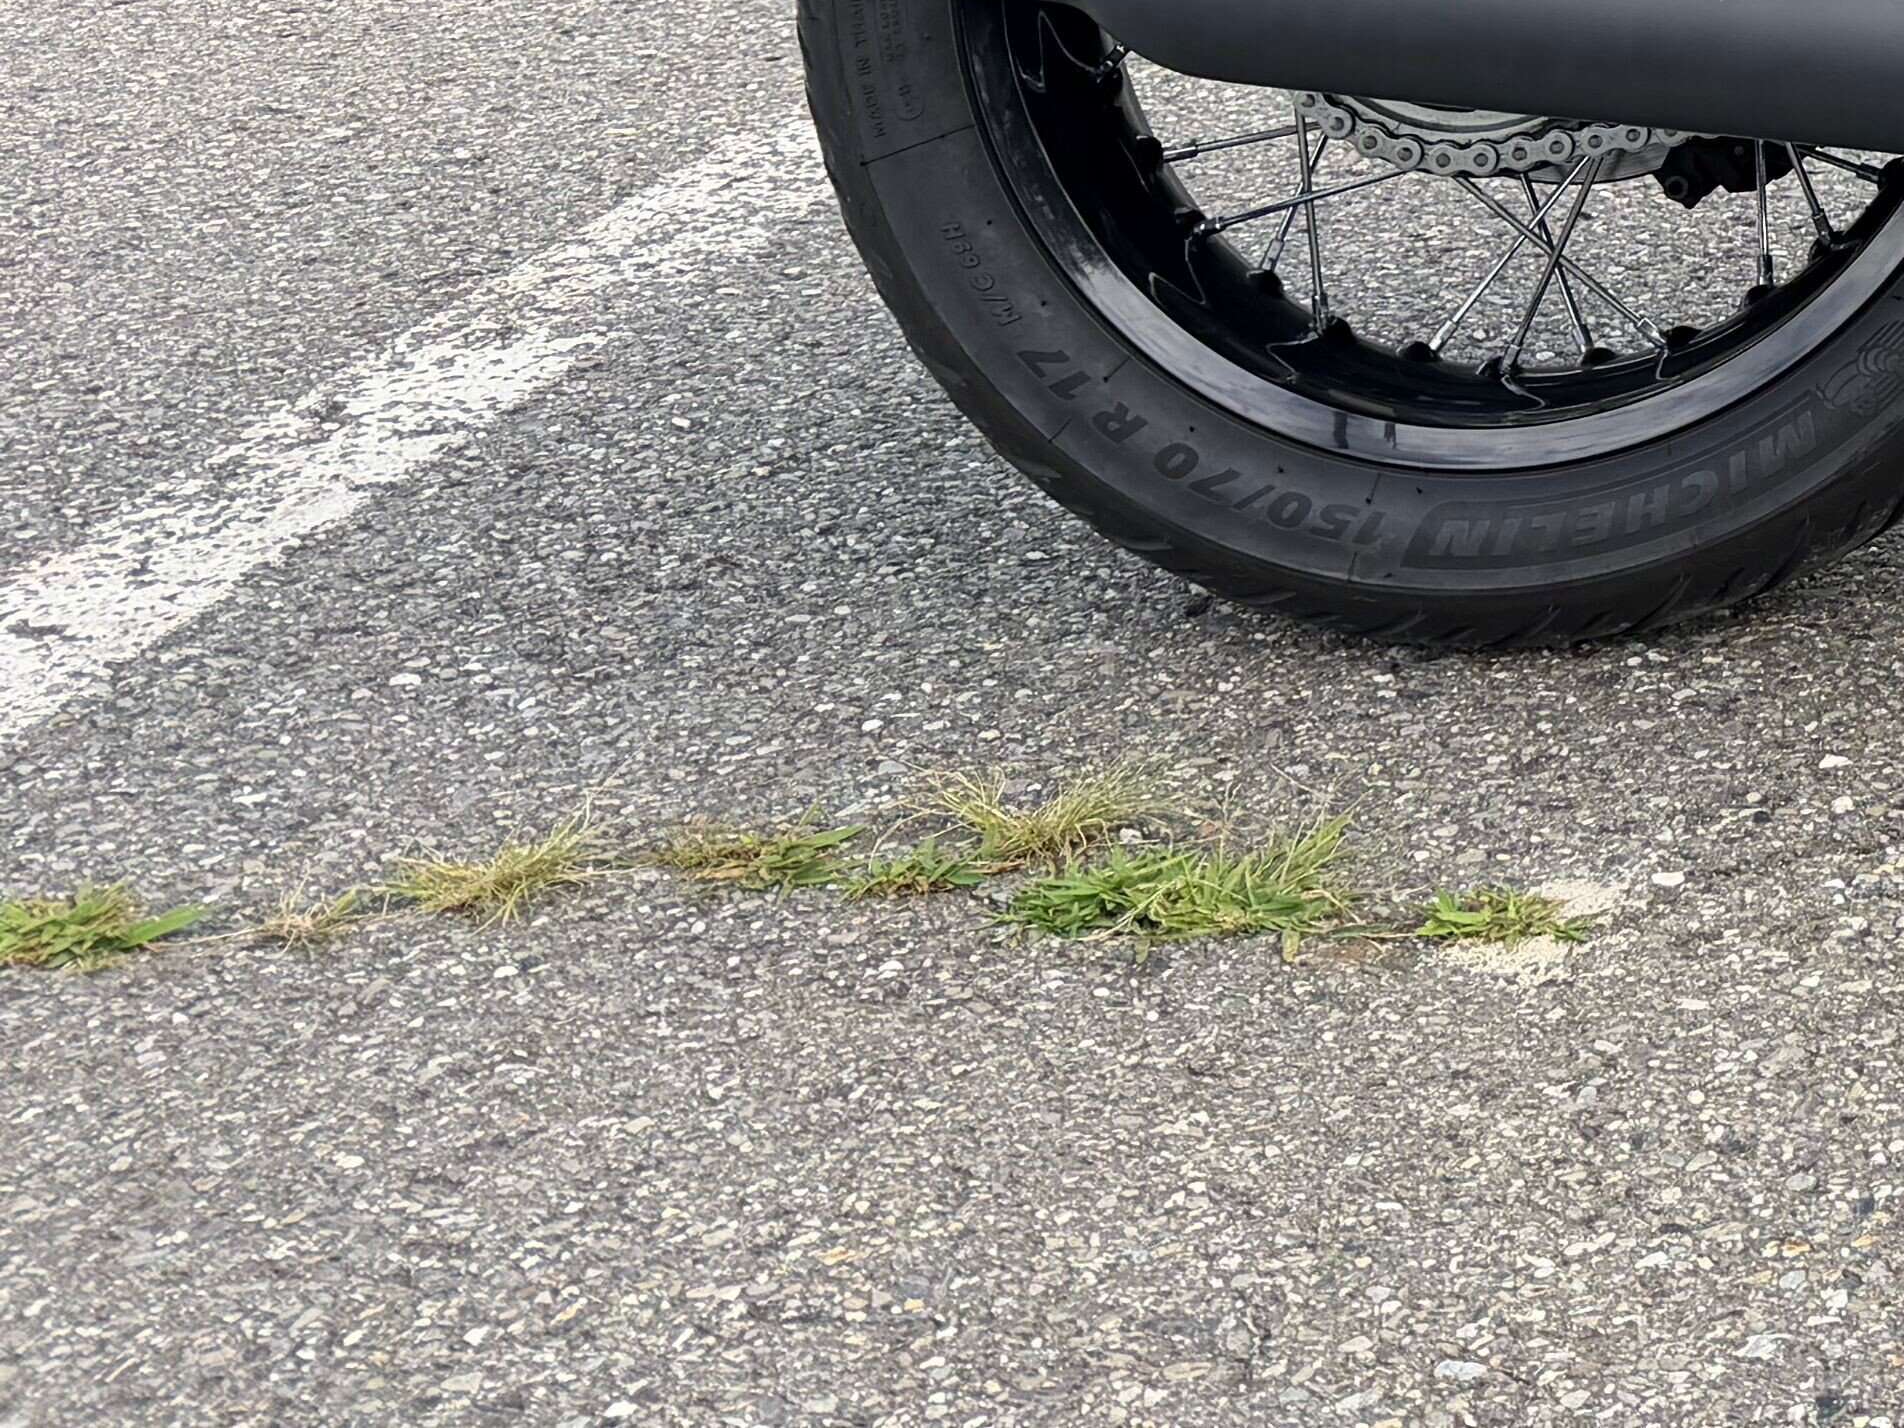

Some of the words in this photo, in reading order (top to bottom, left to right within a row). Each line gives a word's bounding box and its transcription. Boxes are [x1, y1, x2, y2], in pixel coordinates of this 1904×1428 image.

[1014, 329, 1094, 410] 17
[1086, 392, 1151, 455] R
[1147, 431, 1391, 554] 150/70
[1427, 406, 1830, 557] MICHELIN
